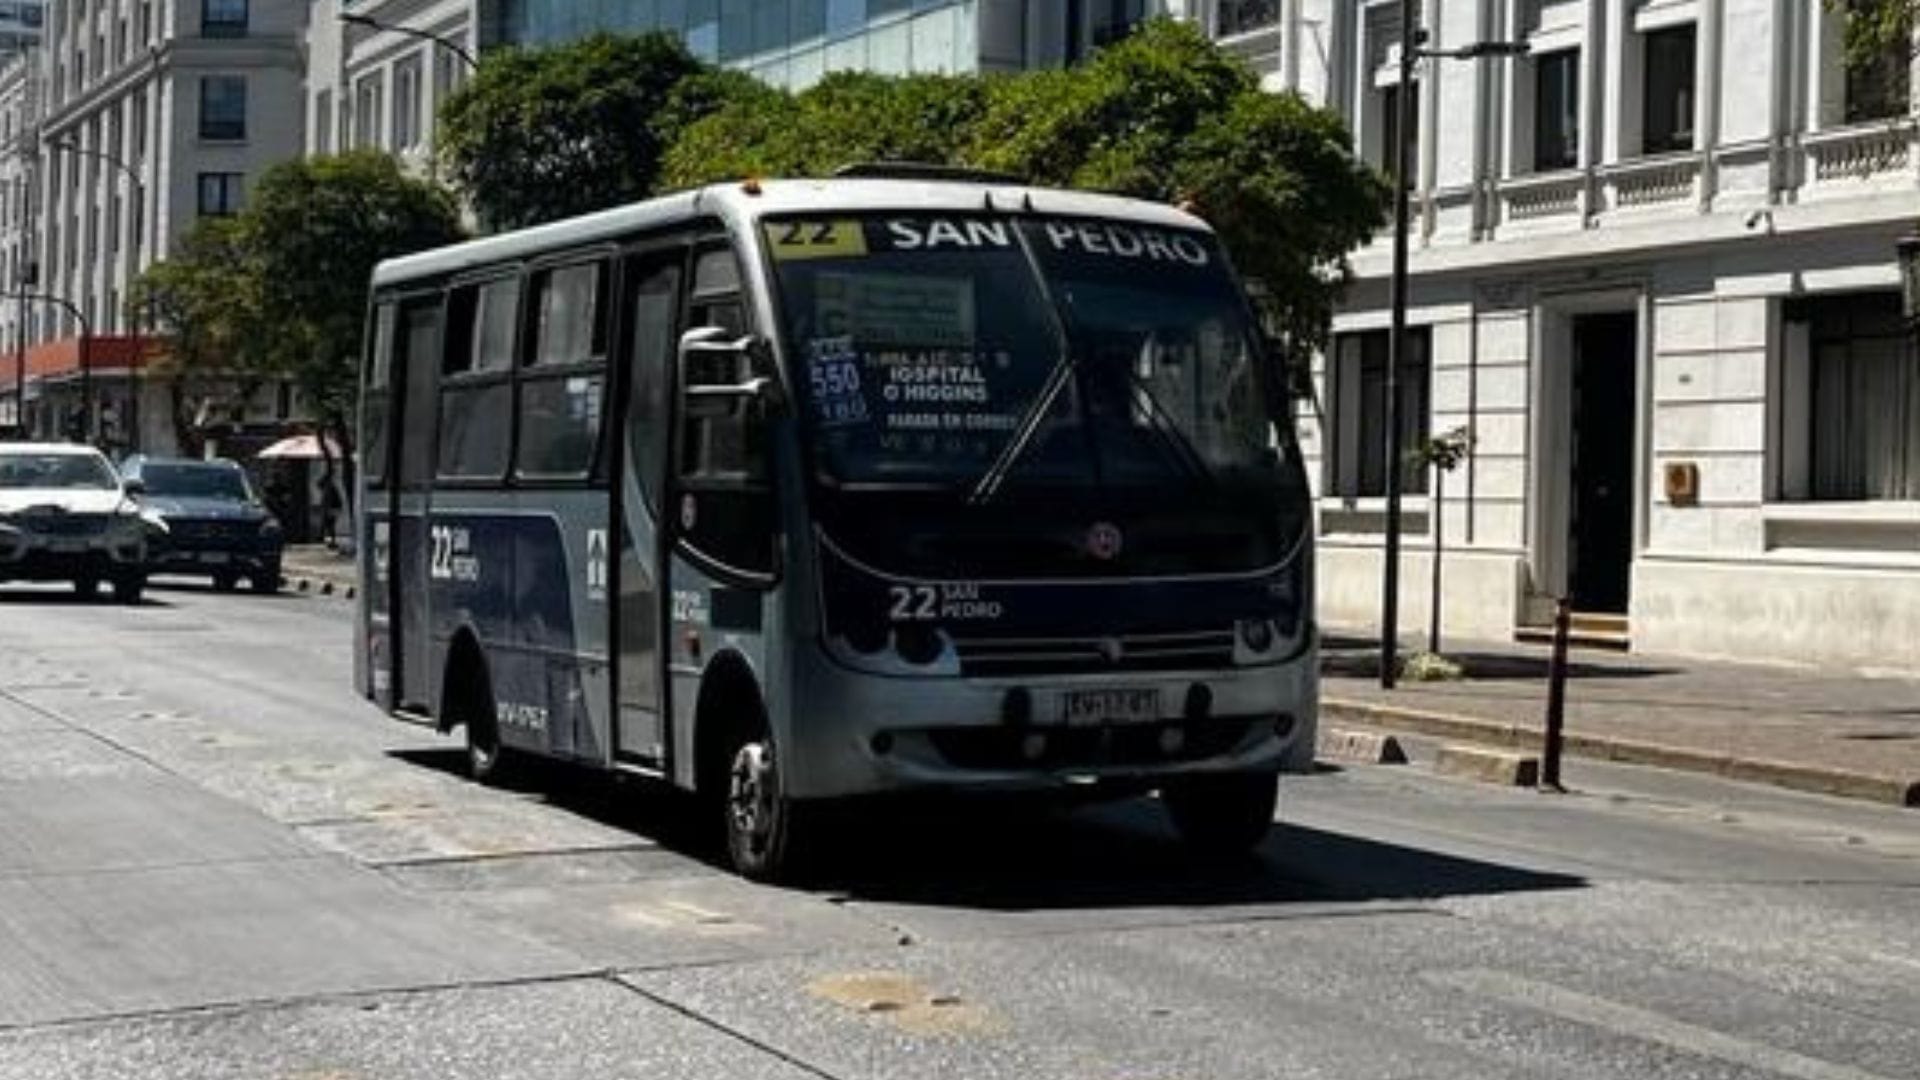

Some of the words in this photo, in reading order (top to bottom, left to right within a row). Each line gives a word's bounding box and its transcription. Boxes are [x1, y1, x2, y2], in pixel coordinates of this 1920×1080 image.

[777, 219, 838, 245] 22
[887, 219, 1010, 248] SAN
[1044, 222, 1208, 265] PEDRO
[810, 363, 861, 397] 550
[905, 384, 987, 402] HIGGINS
[431, 525, 451, 578] 22
[889, 586, 937, 619] 22
[942, 581, 979, 599] SAN
[942, 601, 1002, 618] PEDRO
